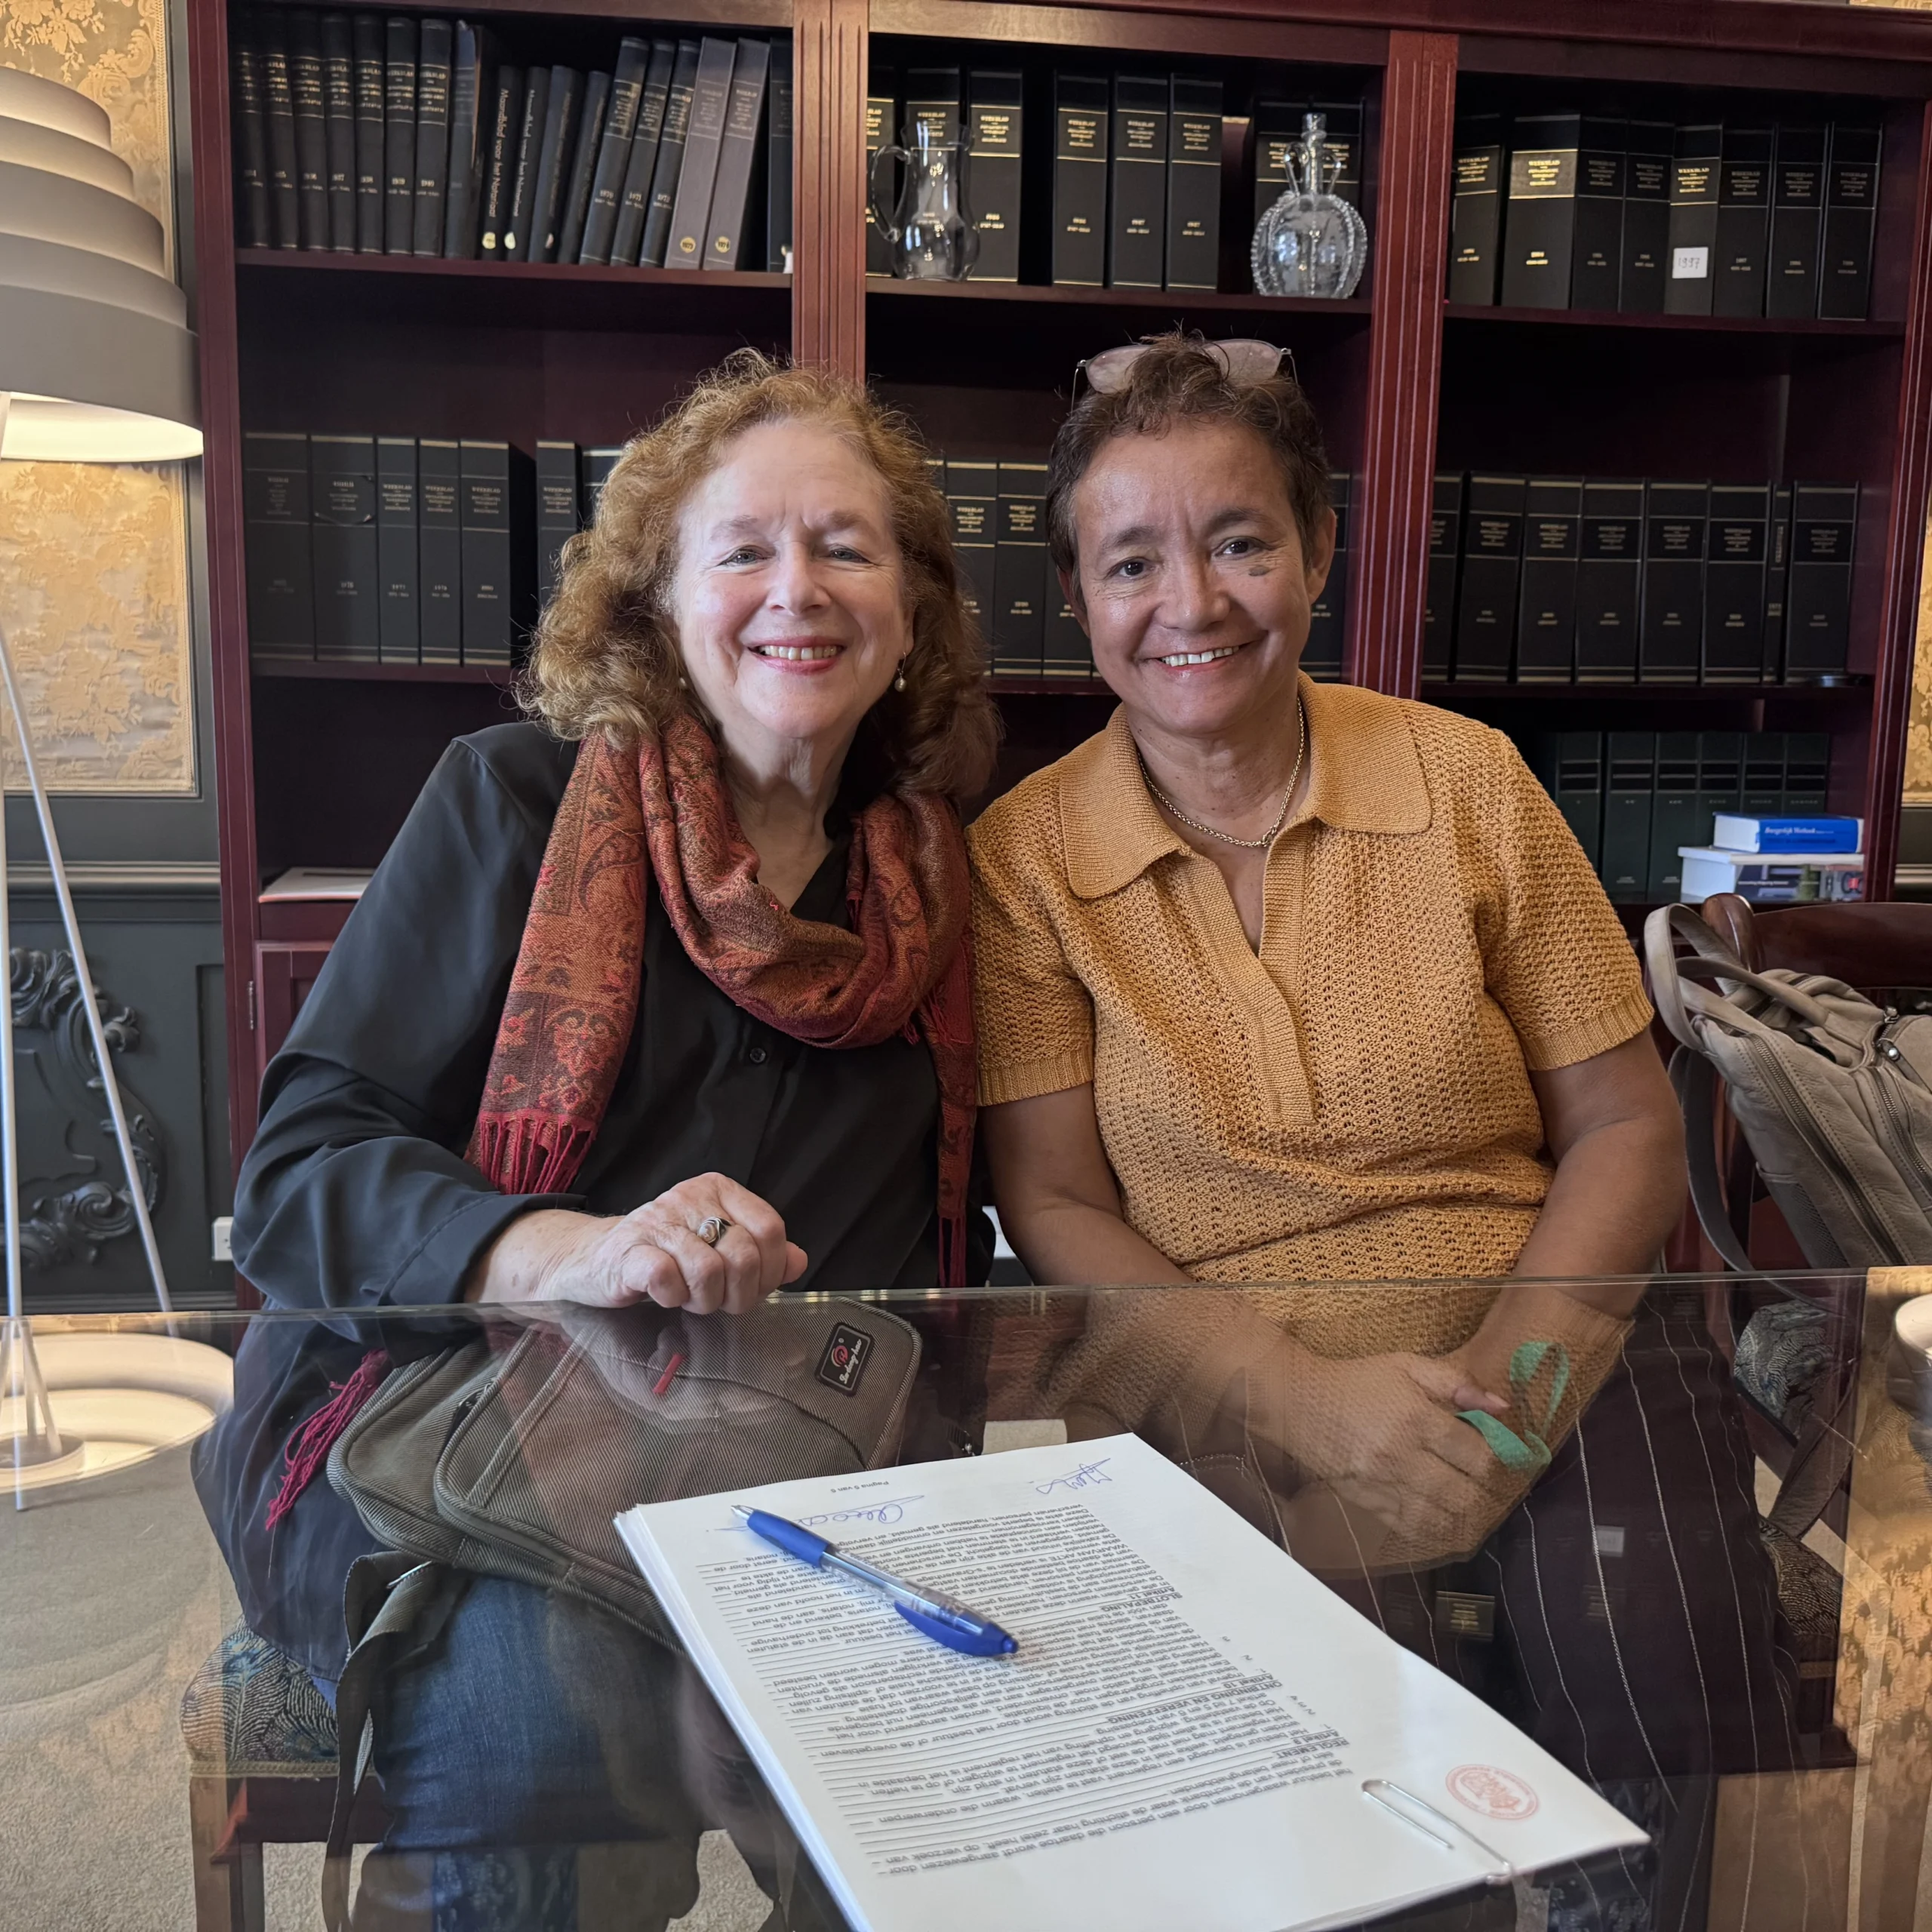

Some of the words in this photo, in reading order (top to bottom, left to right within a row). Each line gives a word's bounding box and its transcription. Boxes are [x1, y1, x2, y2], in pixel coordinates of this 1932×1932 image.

[497, 88, 509, 137] Maandblad
[493, 161, 503, 175] het
[489, 176, 501, 217] Notariaat
[1678, 257, 1701, 269] 1997
